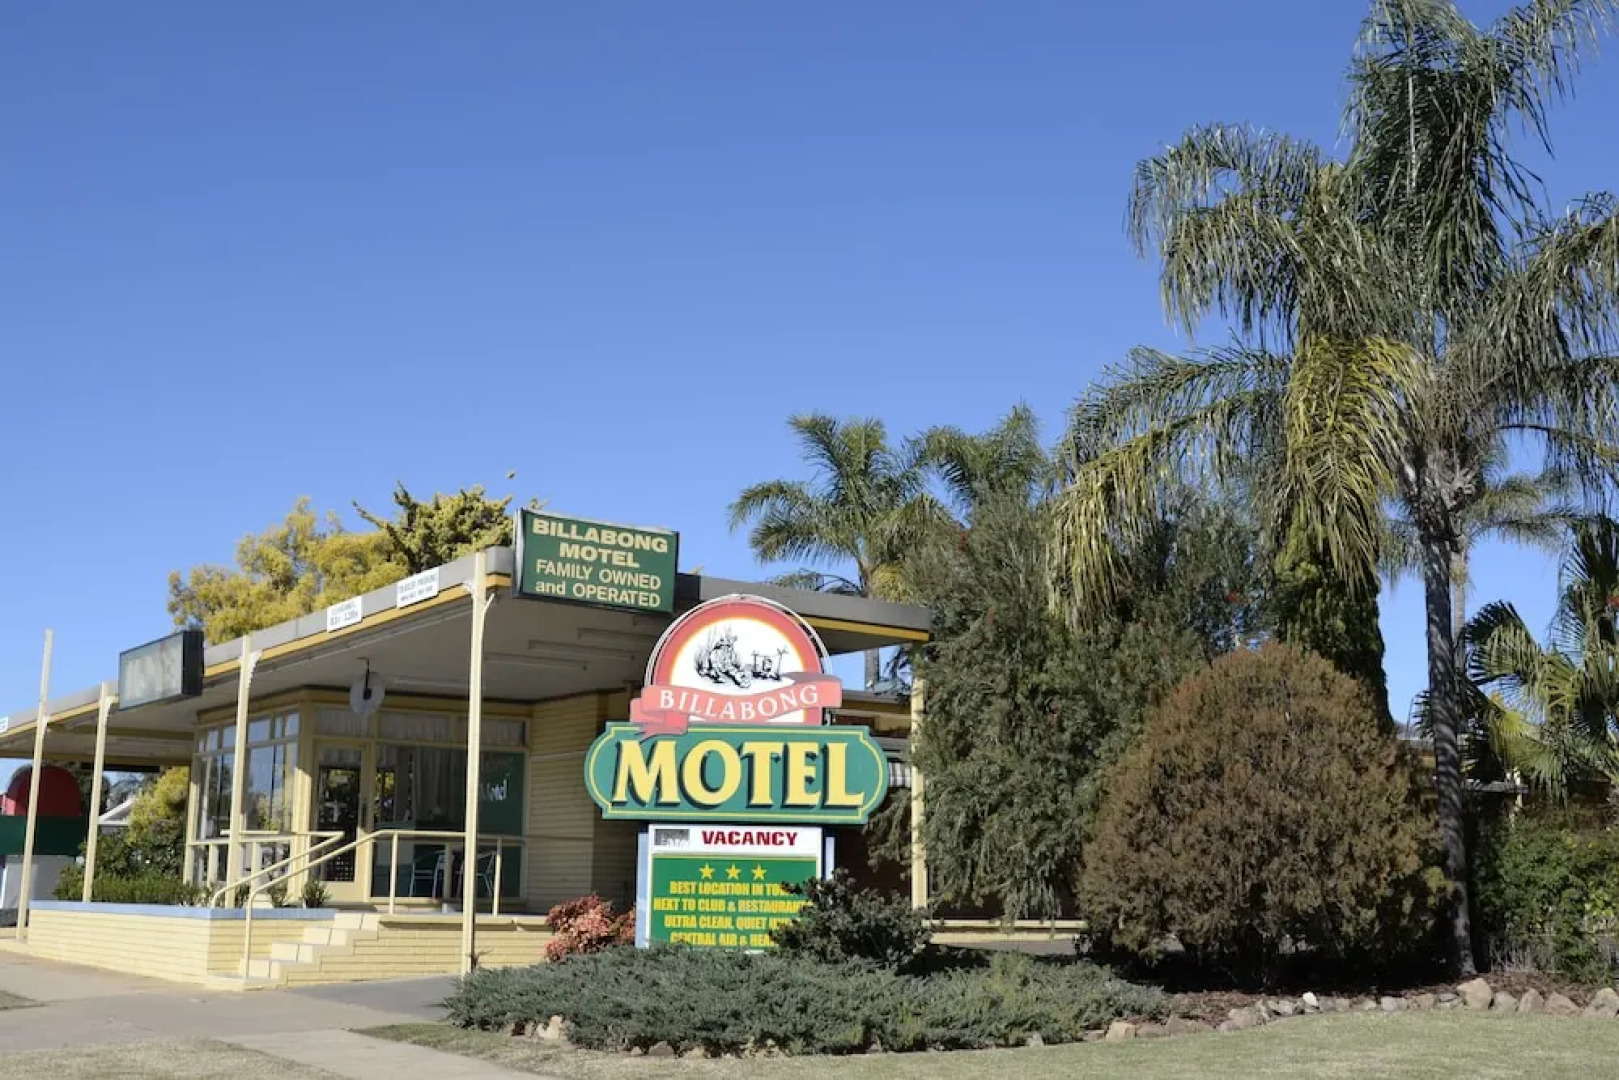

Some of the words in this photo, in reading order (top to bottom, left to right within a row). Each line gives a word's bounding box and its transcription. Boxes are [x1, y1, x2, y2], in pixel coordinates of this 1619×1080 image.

[532, 517, 668, 553] BILLABONG
[559, 542, 641, 568] MOTEL
[535, 558, 593, 580] FAMILY
[598, 568, 662, 590] OWNED
[535, 580, 566, 595] and
[572, 582, 662, 608] OPERATED
[659, 684, 820, 721] BILLABONG
[612, 739, 866, 808] MOTEL
[702, 830, 799, 846] VACANCY
[669, 880, 698, 895] BEST
[698, 881, 750, 896] LOCATION
[752, 883, 764, 897] IN
[653, 896, 680, 911] NEXT
[681, 898, 696, 911] TO
[697, 898, 726, 912] CLUB
[727, 901, 736, 913] &
[664, 914, 697, 929] ULTRA
[736, 916, 768, 931] QUIET
[718, 932, 738, 947] AIR
